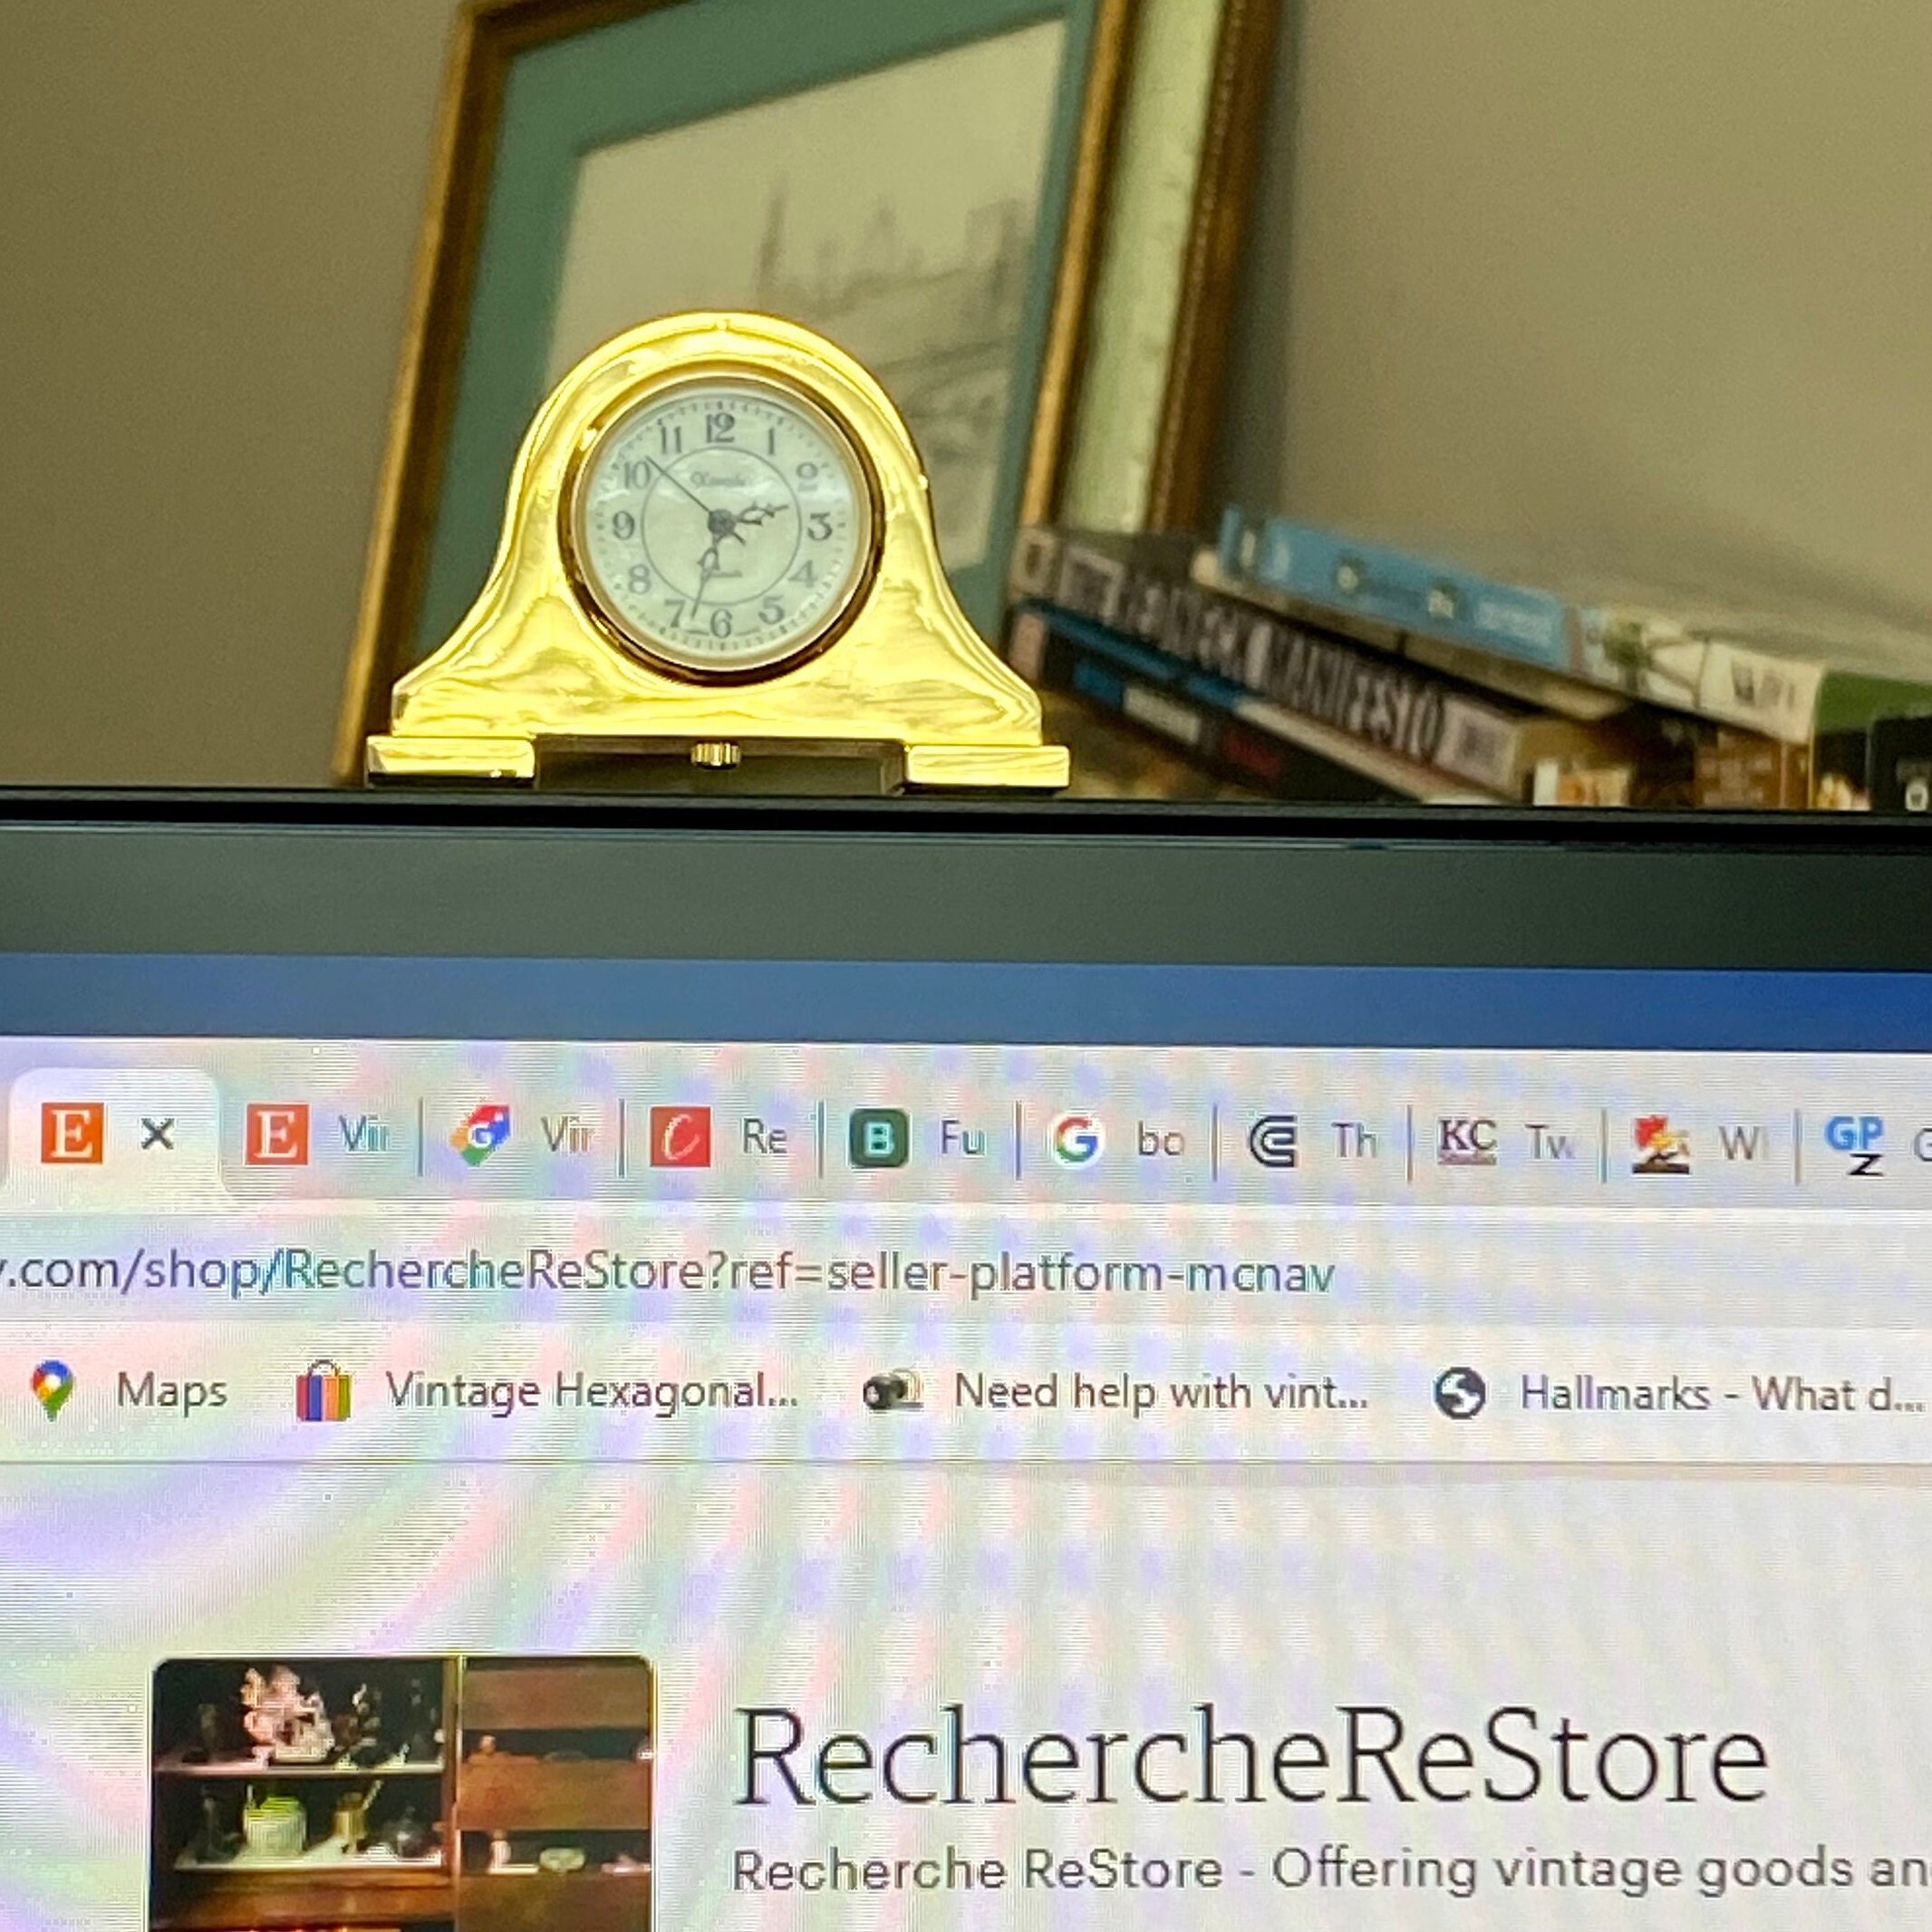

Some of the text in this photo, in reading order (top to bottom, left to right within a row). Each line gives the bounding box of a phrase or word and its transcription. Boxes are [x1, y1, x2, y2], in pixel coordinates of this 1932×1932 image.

[661, 426, 682, 454] 11
[705, 412, 736, 443] 12
[768, 428, 777, 455] 1
[623, 459, 652, 490] 10
[612, 510, 636, 541] 9
[807, 512, 833, 542] 3
[628, 564, 652, 594] 8
[787, 559, 815, 588] 4
[664, 599, 686, 628] 7
[710, 608, 733, 638] 6
[758, 595, 786, 624] 5
[52, 1108, 94, 1158] E
[254, 1111, 299, 1159] E
[742, 1118, 787, 1156] Re
[941, 1119, 985, 1156] Fu
[1137, 1121, 1184, 1157] bo
[1330, 1122, 1377, 1158] Th
[1438, 1119, 1497, 1150] KC
[1823, 1116, 1885, 1150] GP
[117, 1371, 227, 1418] Maps
[386, 1370, 798, 1418] Vintage Hexagonal...
[956, 1372, 1369, 1418] Need help with vint...
[1521, 1375, 1711, 1412] Hallmarks
[1752, 1375, 1856, 1412] What
[1869, 1376, 1927, 1413] d...
[734, 1703, 1769, 1805] RechercheReStore
[733, 1846, 1008, 1891] Recherche
[1025, 1847, 1223, 1890] ReStore
[1273, 1843, 1477, 1898] Offering
[1493, 1846, 1683, 1898] vintage
[1698, 1844, 1853, 1898] goods
[1869, 1858, 1932, 1888] an
